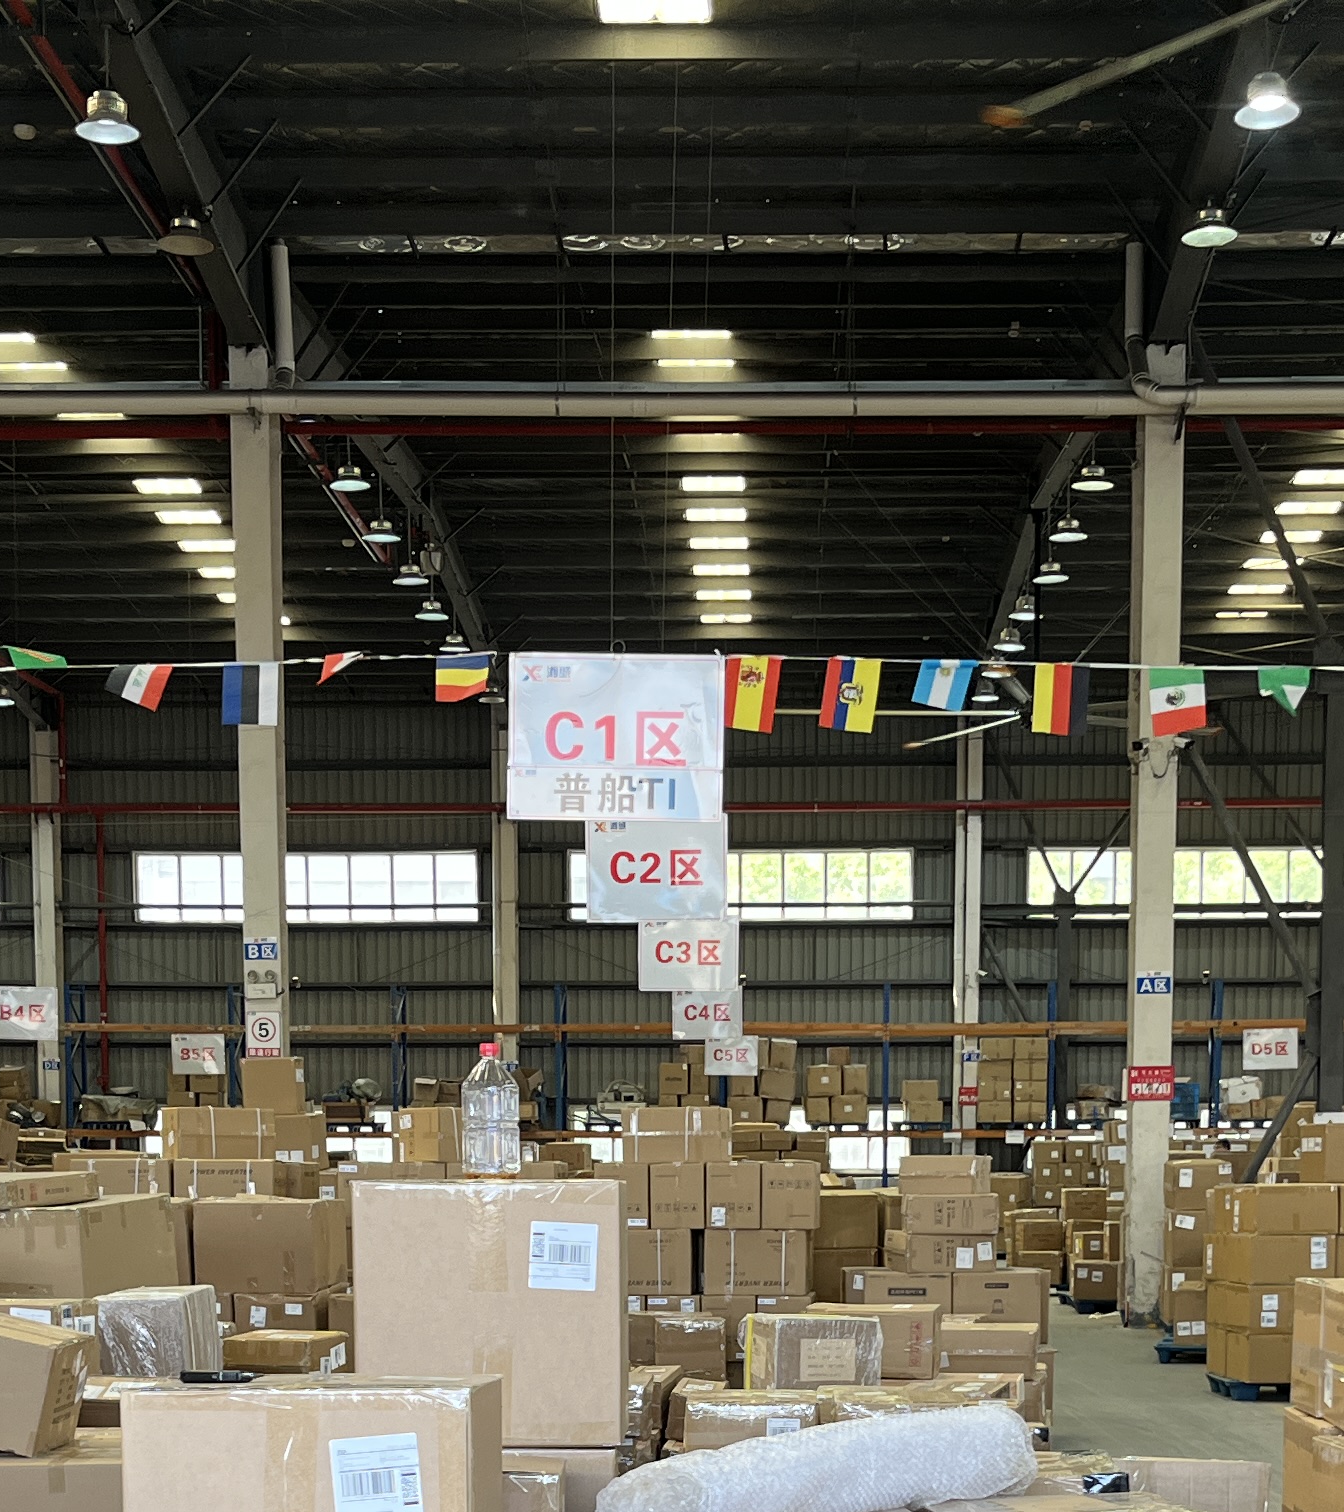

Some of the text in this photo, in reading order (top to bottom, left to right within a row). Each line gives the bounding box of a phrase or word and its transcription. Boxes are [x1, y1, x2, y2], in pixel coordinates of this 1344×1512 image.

[546, 712, 686, 766] C1区
[611, 850, 700, 885] C2区
[248, 946, 273, 960] B区
[656, 940, 720, 965] C3区
[1140, 979, 1169, 993] A区
[0, 1005, 44, 1023] B4区
[684, 1004, 730, 1021] C4区
[259, 1023, 269, 1037] 5
[181, 1048, 214, 1060] B5区
[713, 1048, 748, 1062] C5区
[1252, 1042, 1287, 1055] D5区
[190, 1168, 254, 1177] PWER INVERTR
[725, 1280, 762, 1288] INVERTR
